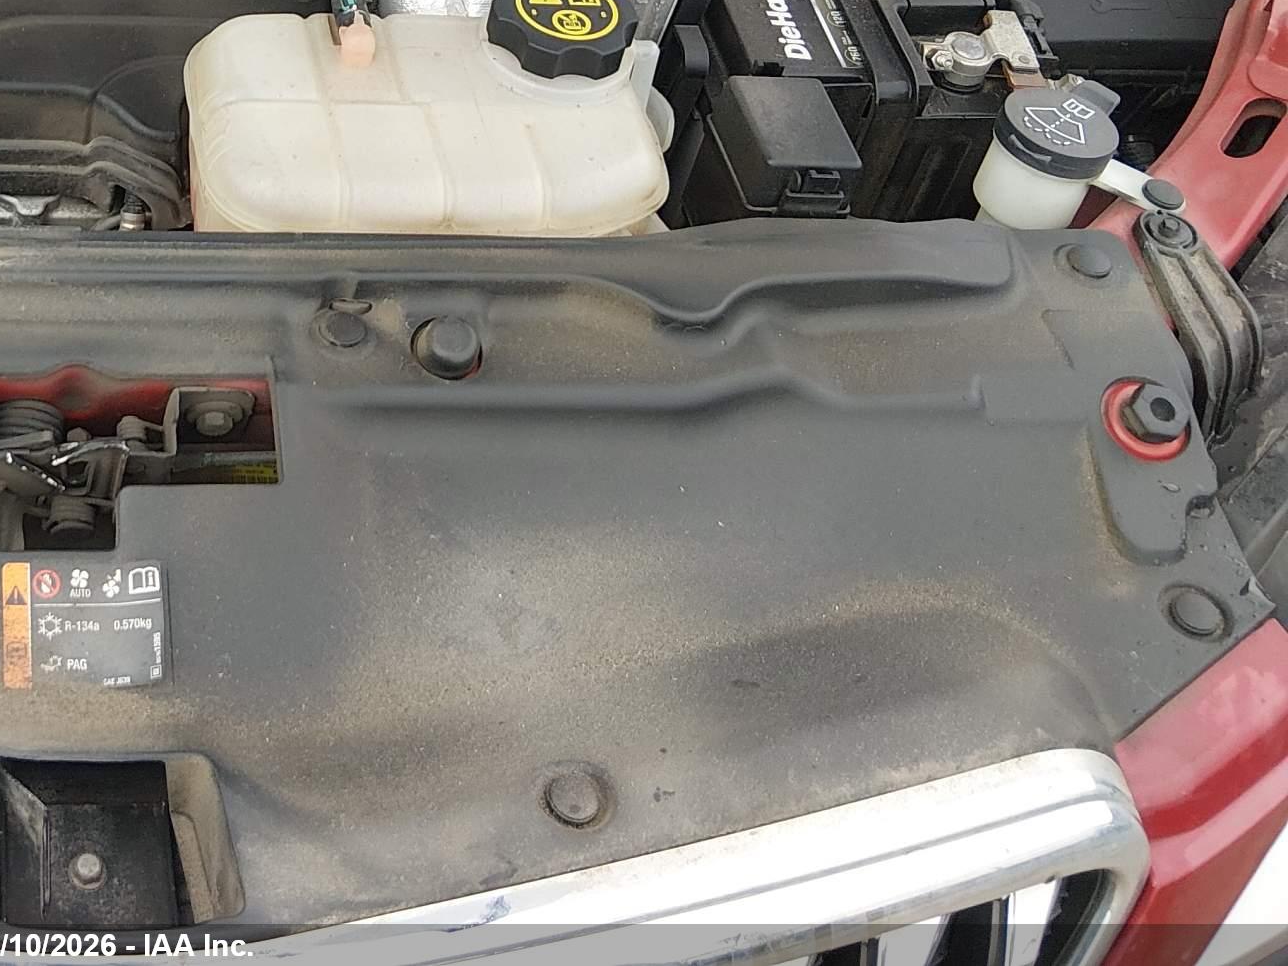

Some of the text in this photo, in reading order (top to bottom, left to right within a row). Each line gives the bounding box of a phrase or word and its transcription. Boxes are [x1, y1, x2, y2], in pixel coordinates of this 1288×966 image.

[69, 588, 91, 598] AUTO
[64, 617, 152, 632] R-134a 0.570kg
[66, 658, 88, 671] PAG
